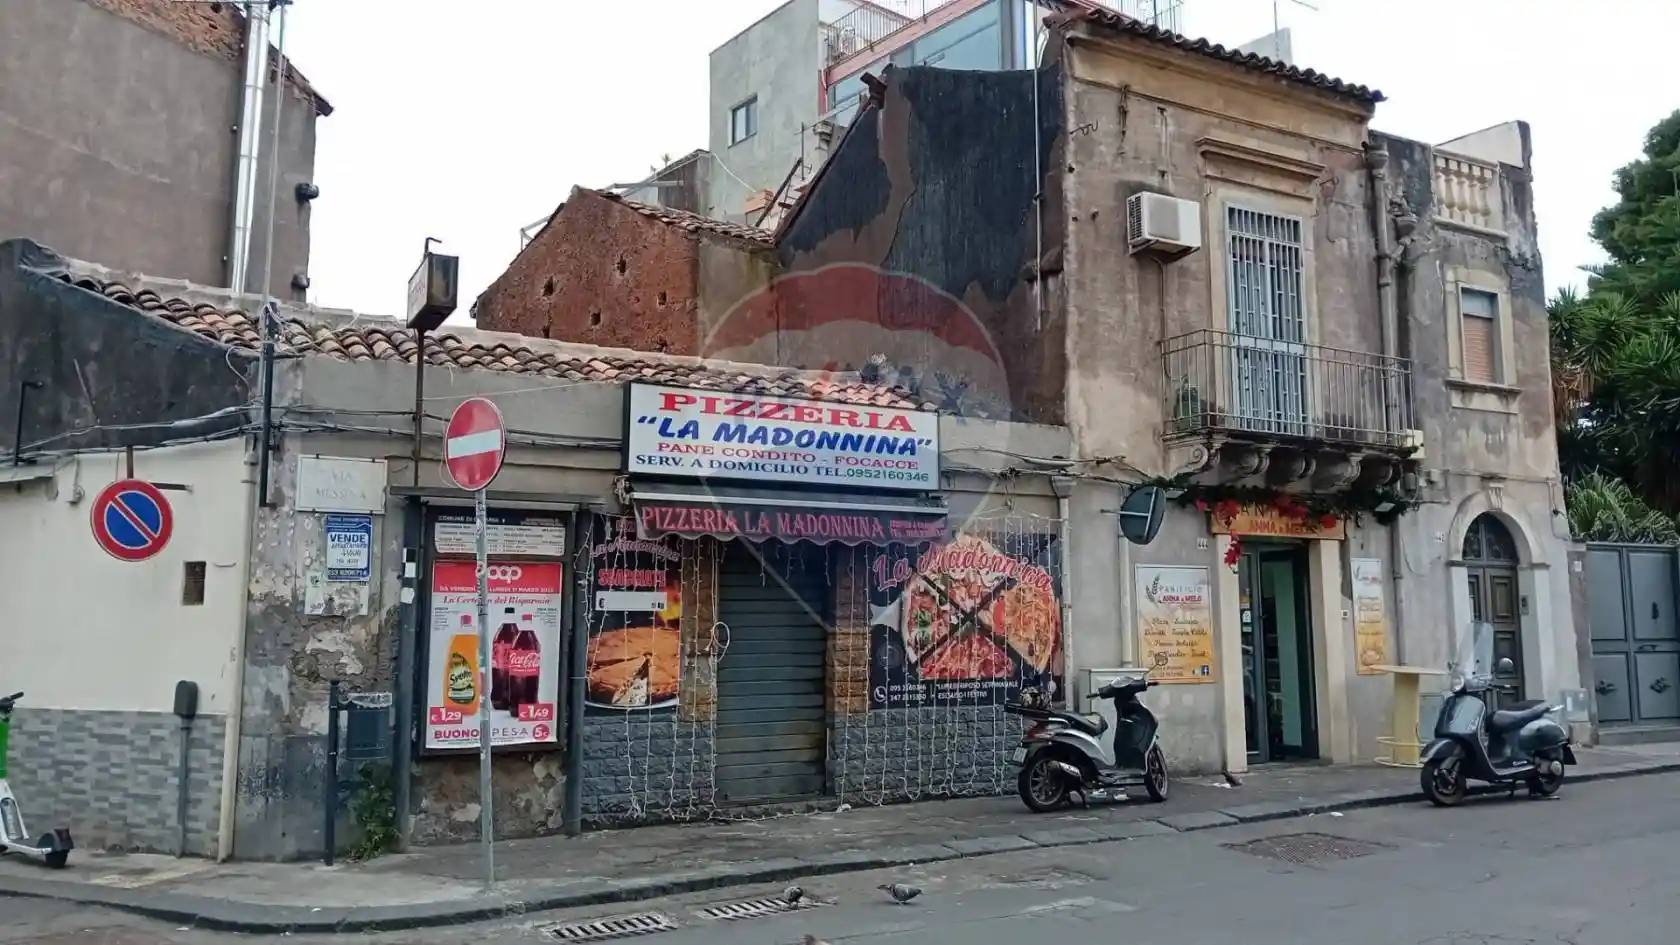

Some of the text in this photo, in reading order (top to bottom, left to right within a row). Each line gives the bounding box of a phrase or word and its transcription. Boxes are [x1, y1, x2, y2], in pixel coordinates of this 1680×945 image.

[658, 391, 917, 433] PIZZERIA
[635, 454, 684, 468] SERV.
[691, 457, 703, 469] A
[708, 458, 809, 476] DOMICILIO
[656, 441, 715, 456] PANE
[722, 446, 816, 463] CONDITO
[834, 454, 919, 471] FOCACCE
[642, 505, 739, 535] PIZZERIA
[745, 509, 770, 534] LA
[776, 511, 885, 539] MADONNINA
[330, 533, 366, 543] VENDE
[873, 542, 1053, 592] La Madonnina
[434, 728, 480, 739] BUONO
